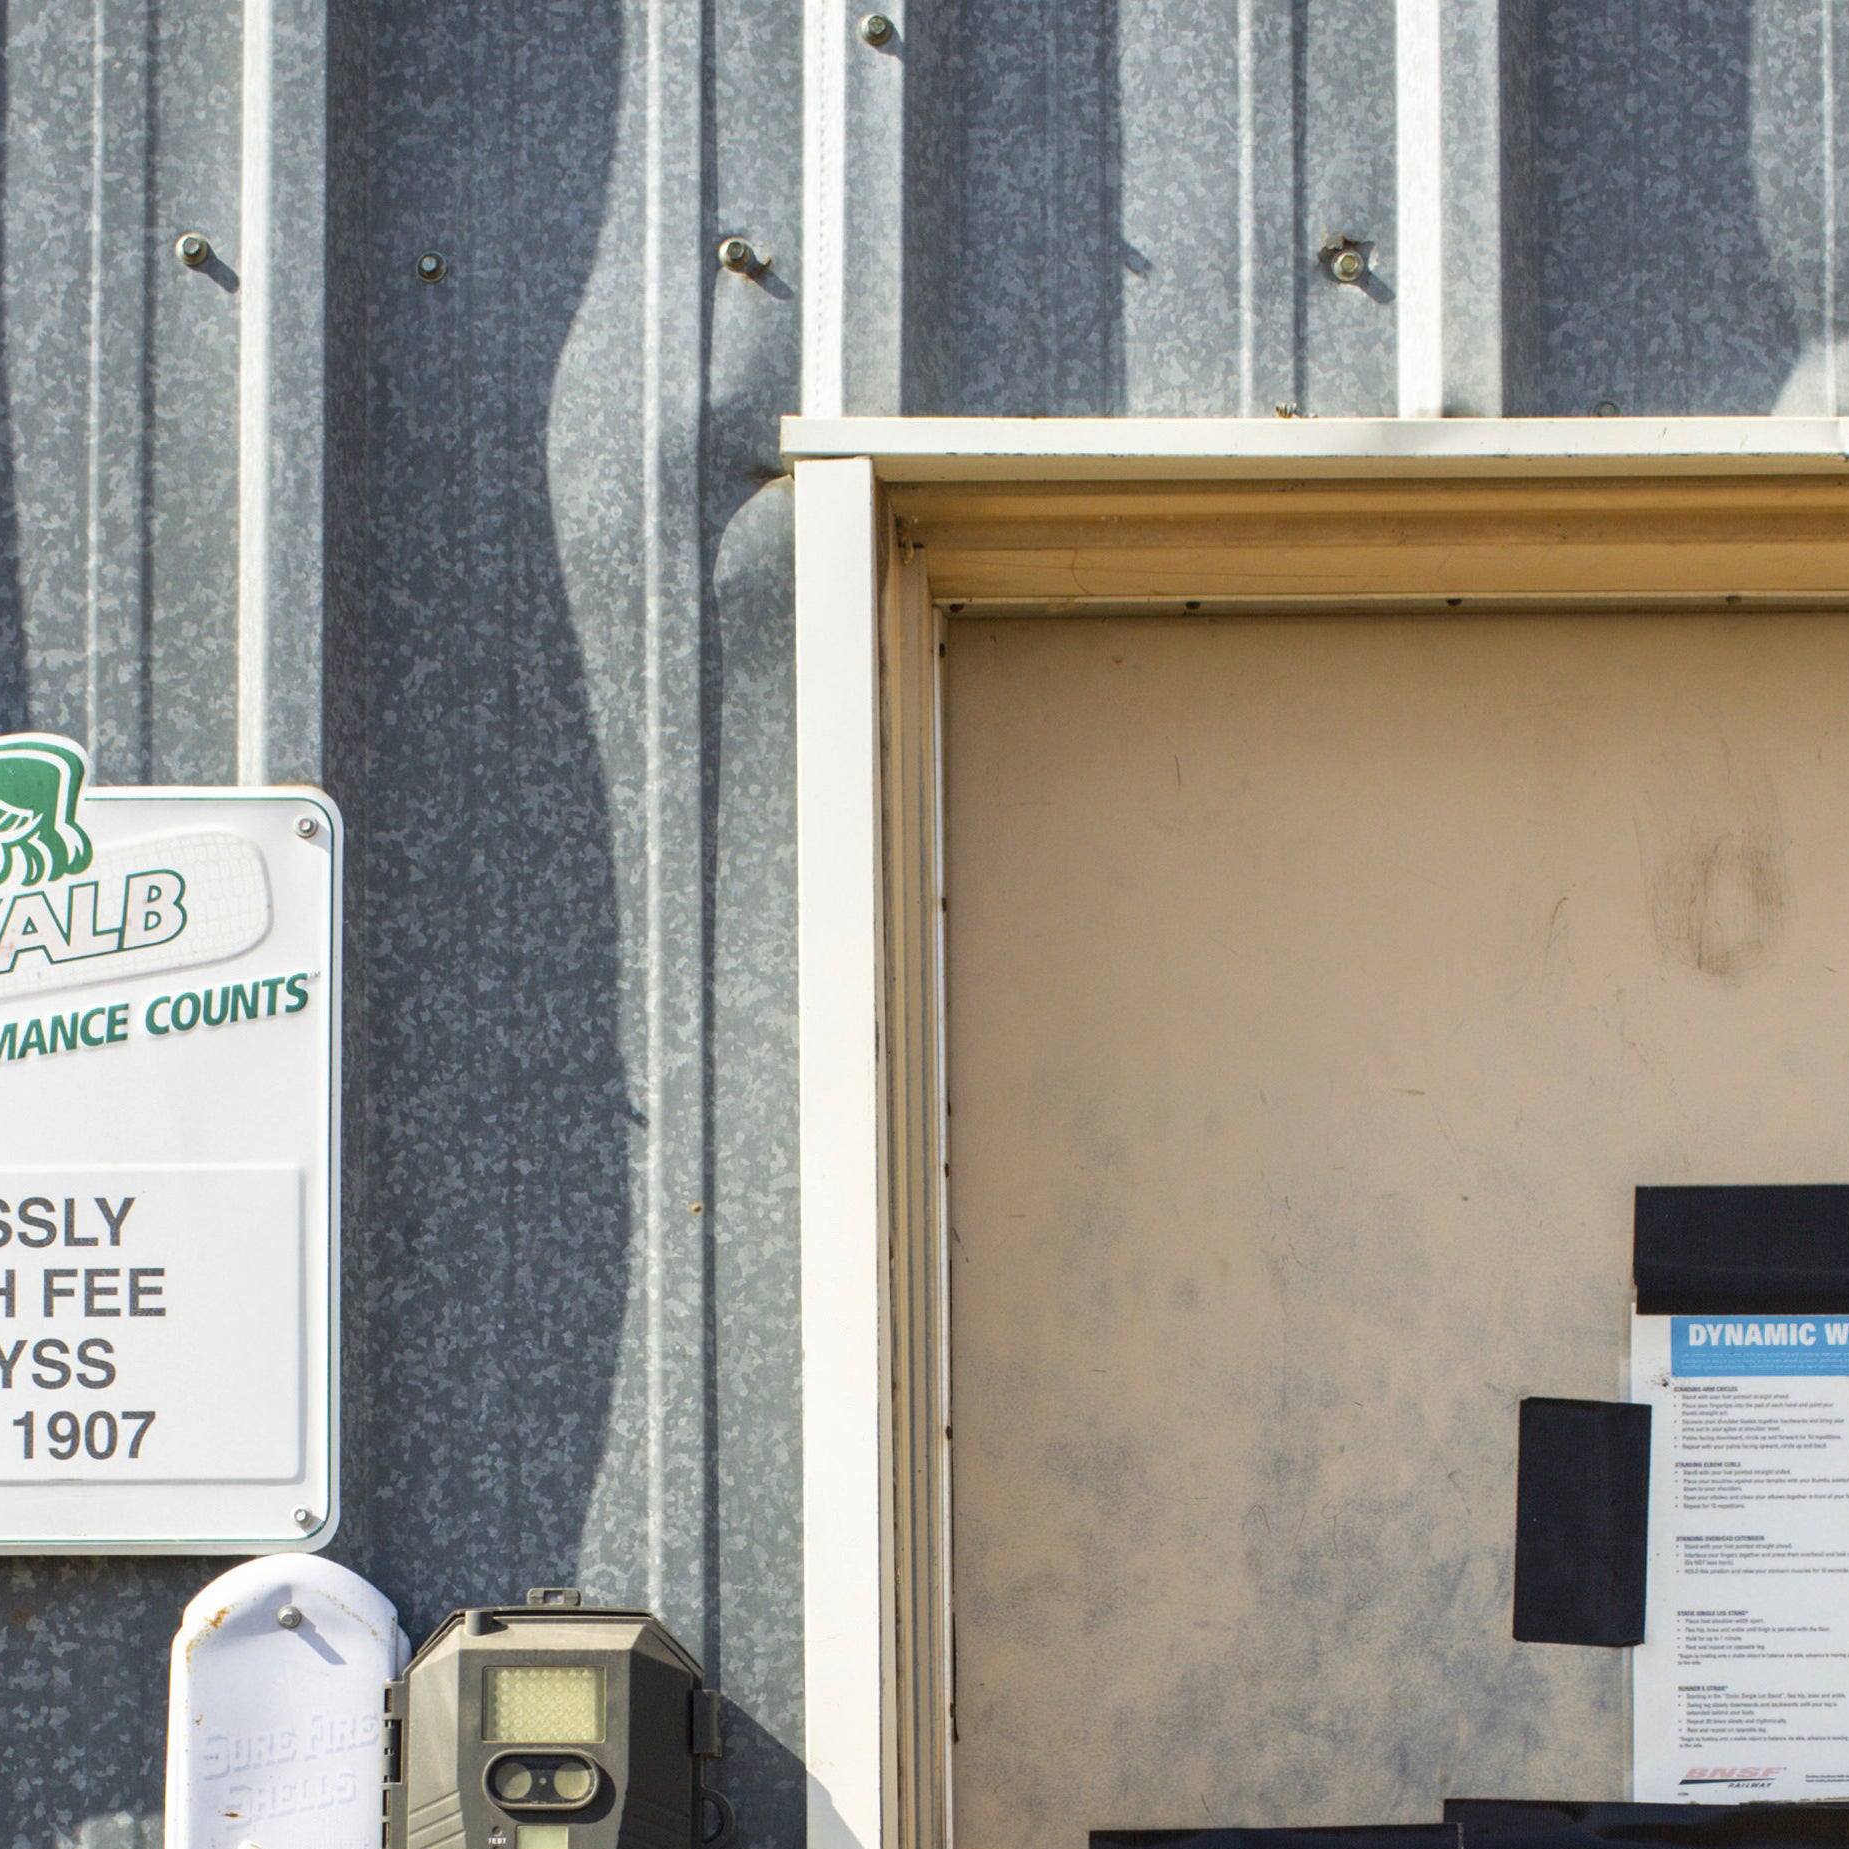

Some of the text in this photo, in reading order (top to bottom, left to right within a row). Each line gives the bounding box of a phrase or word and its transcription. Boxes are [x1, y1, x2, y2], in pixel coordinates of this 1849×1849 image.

[42, 1267, 167, 1318] FEE
[1689, 1323, 1816, 1346] DYNAMIC
[13, 1410, 156, 1460] 1907
[1686, 1767, 1783, 1778] BNSF
[487, 1837, 507, 1845] TEST
